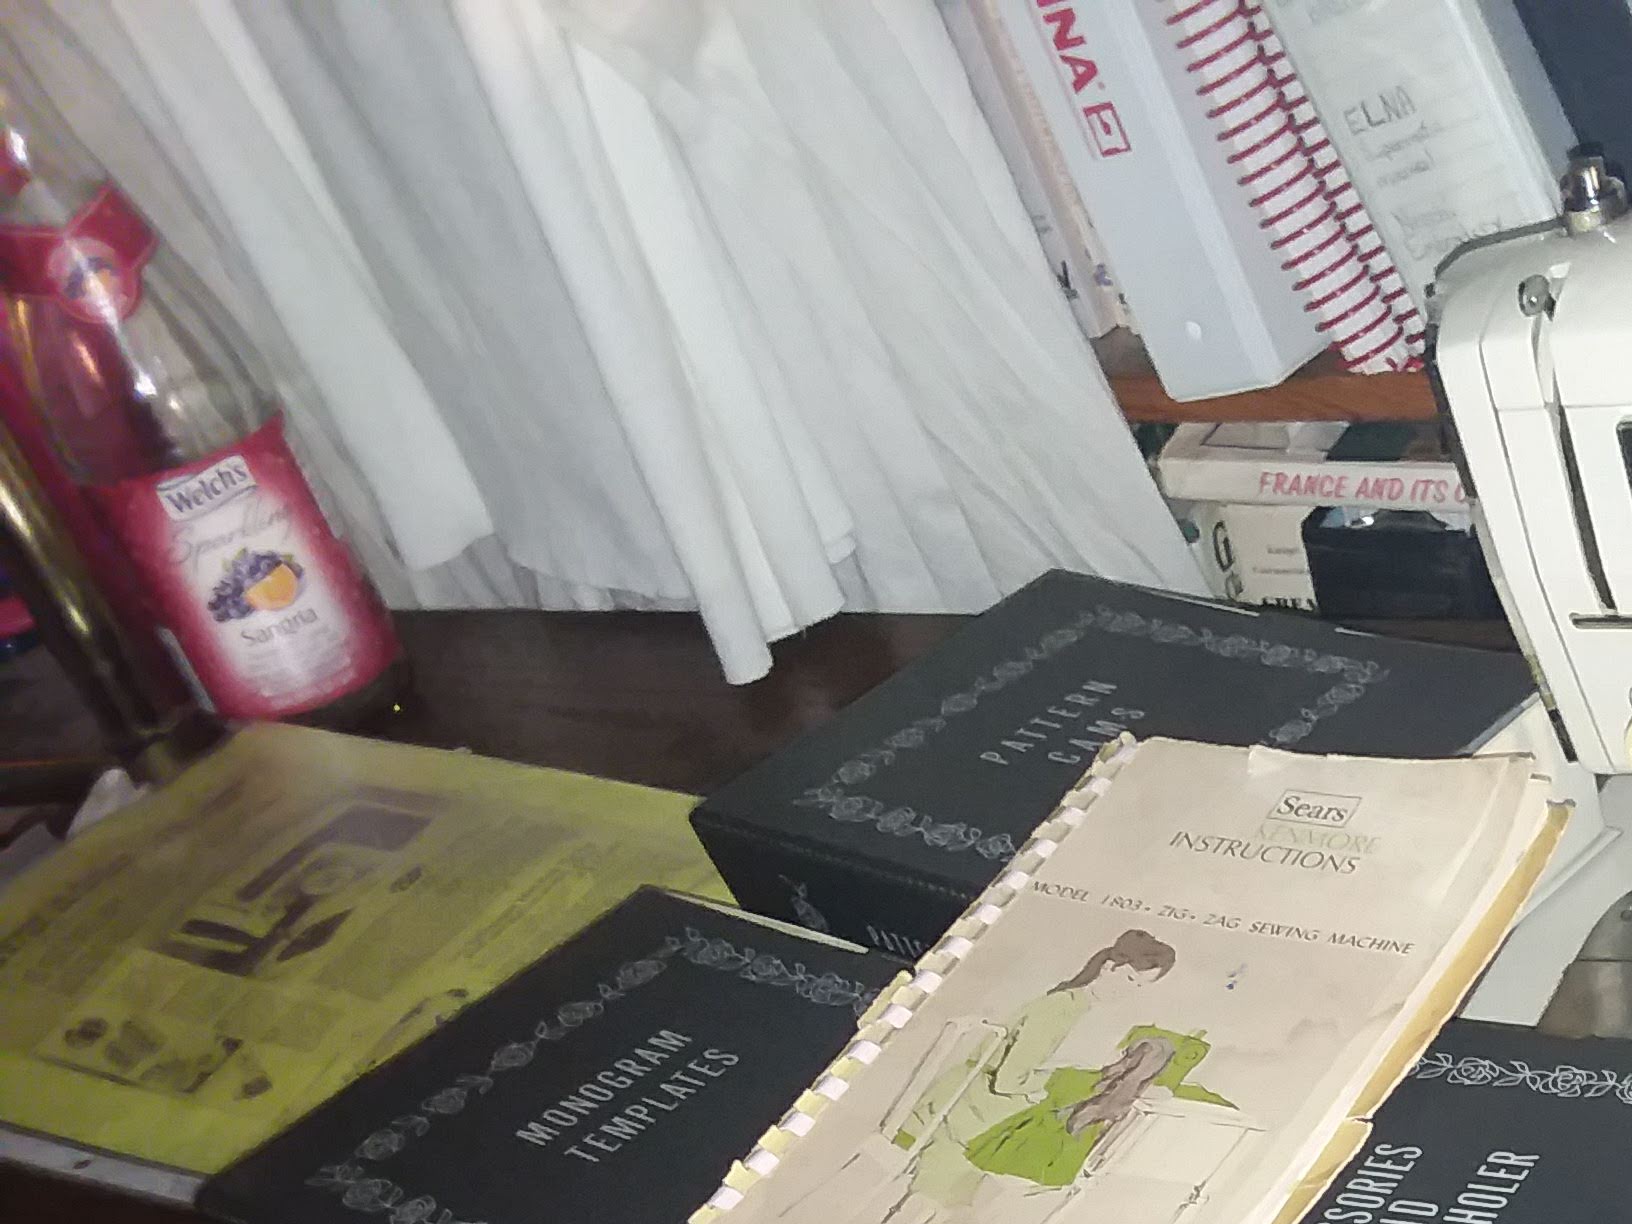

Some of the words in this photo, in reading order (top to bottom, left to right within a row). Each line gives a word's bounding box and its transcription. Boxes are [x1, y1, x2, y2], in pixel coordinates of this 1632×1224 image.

[1037, 0, 1098, 94] NA
[1343, 85, 1417, 136] ELNA
[1259, 471, 1348, 498] FRANCE
[1354, 477, 1404, 501] AND
[1410, 479, 1449, 502] ITS
[240, 607, 319, 646] Sangria
[979, 680, 1118, 765] PATTERN
[1048, 707, 1146, 764] CAMS
[1276, 794, 1349, 822] Sears
[1169, 831, 1361, 874] INSTRUCTIONS
[1034, 881, 1089, 902] MODEL
[1203, 913, 1242, 929] ZAG
[1249, 921, 1320, 942] SEWING
[1328, 932, 1416, 955] MACHINE
[516, 1029, 692, 1146] MONOGRAM
[564, 1049, 740, 1162] TEMPLATES
